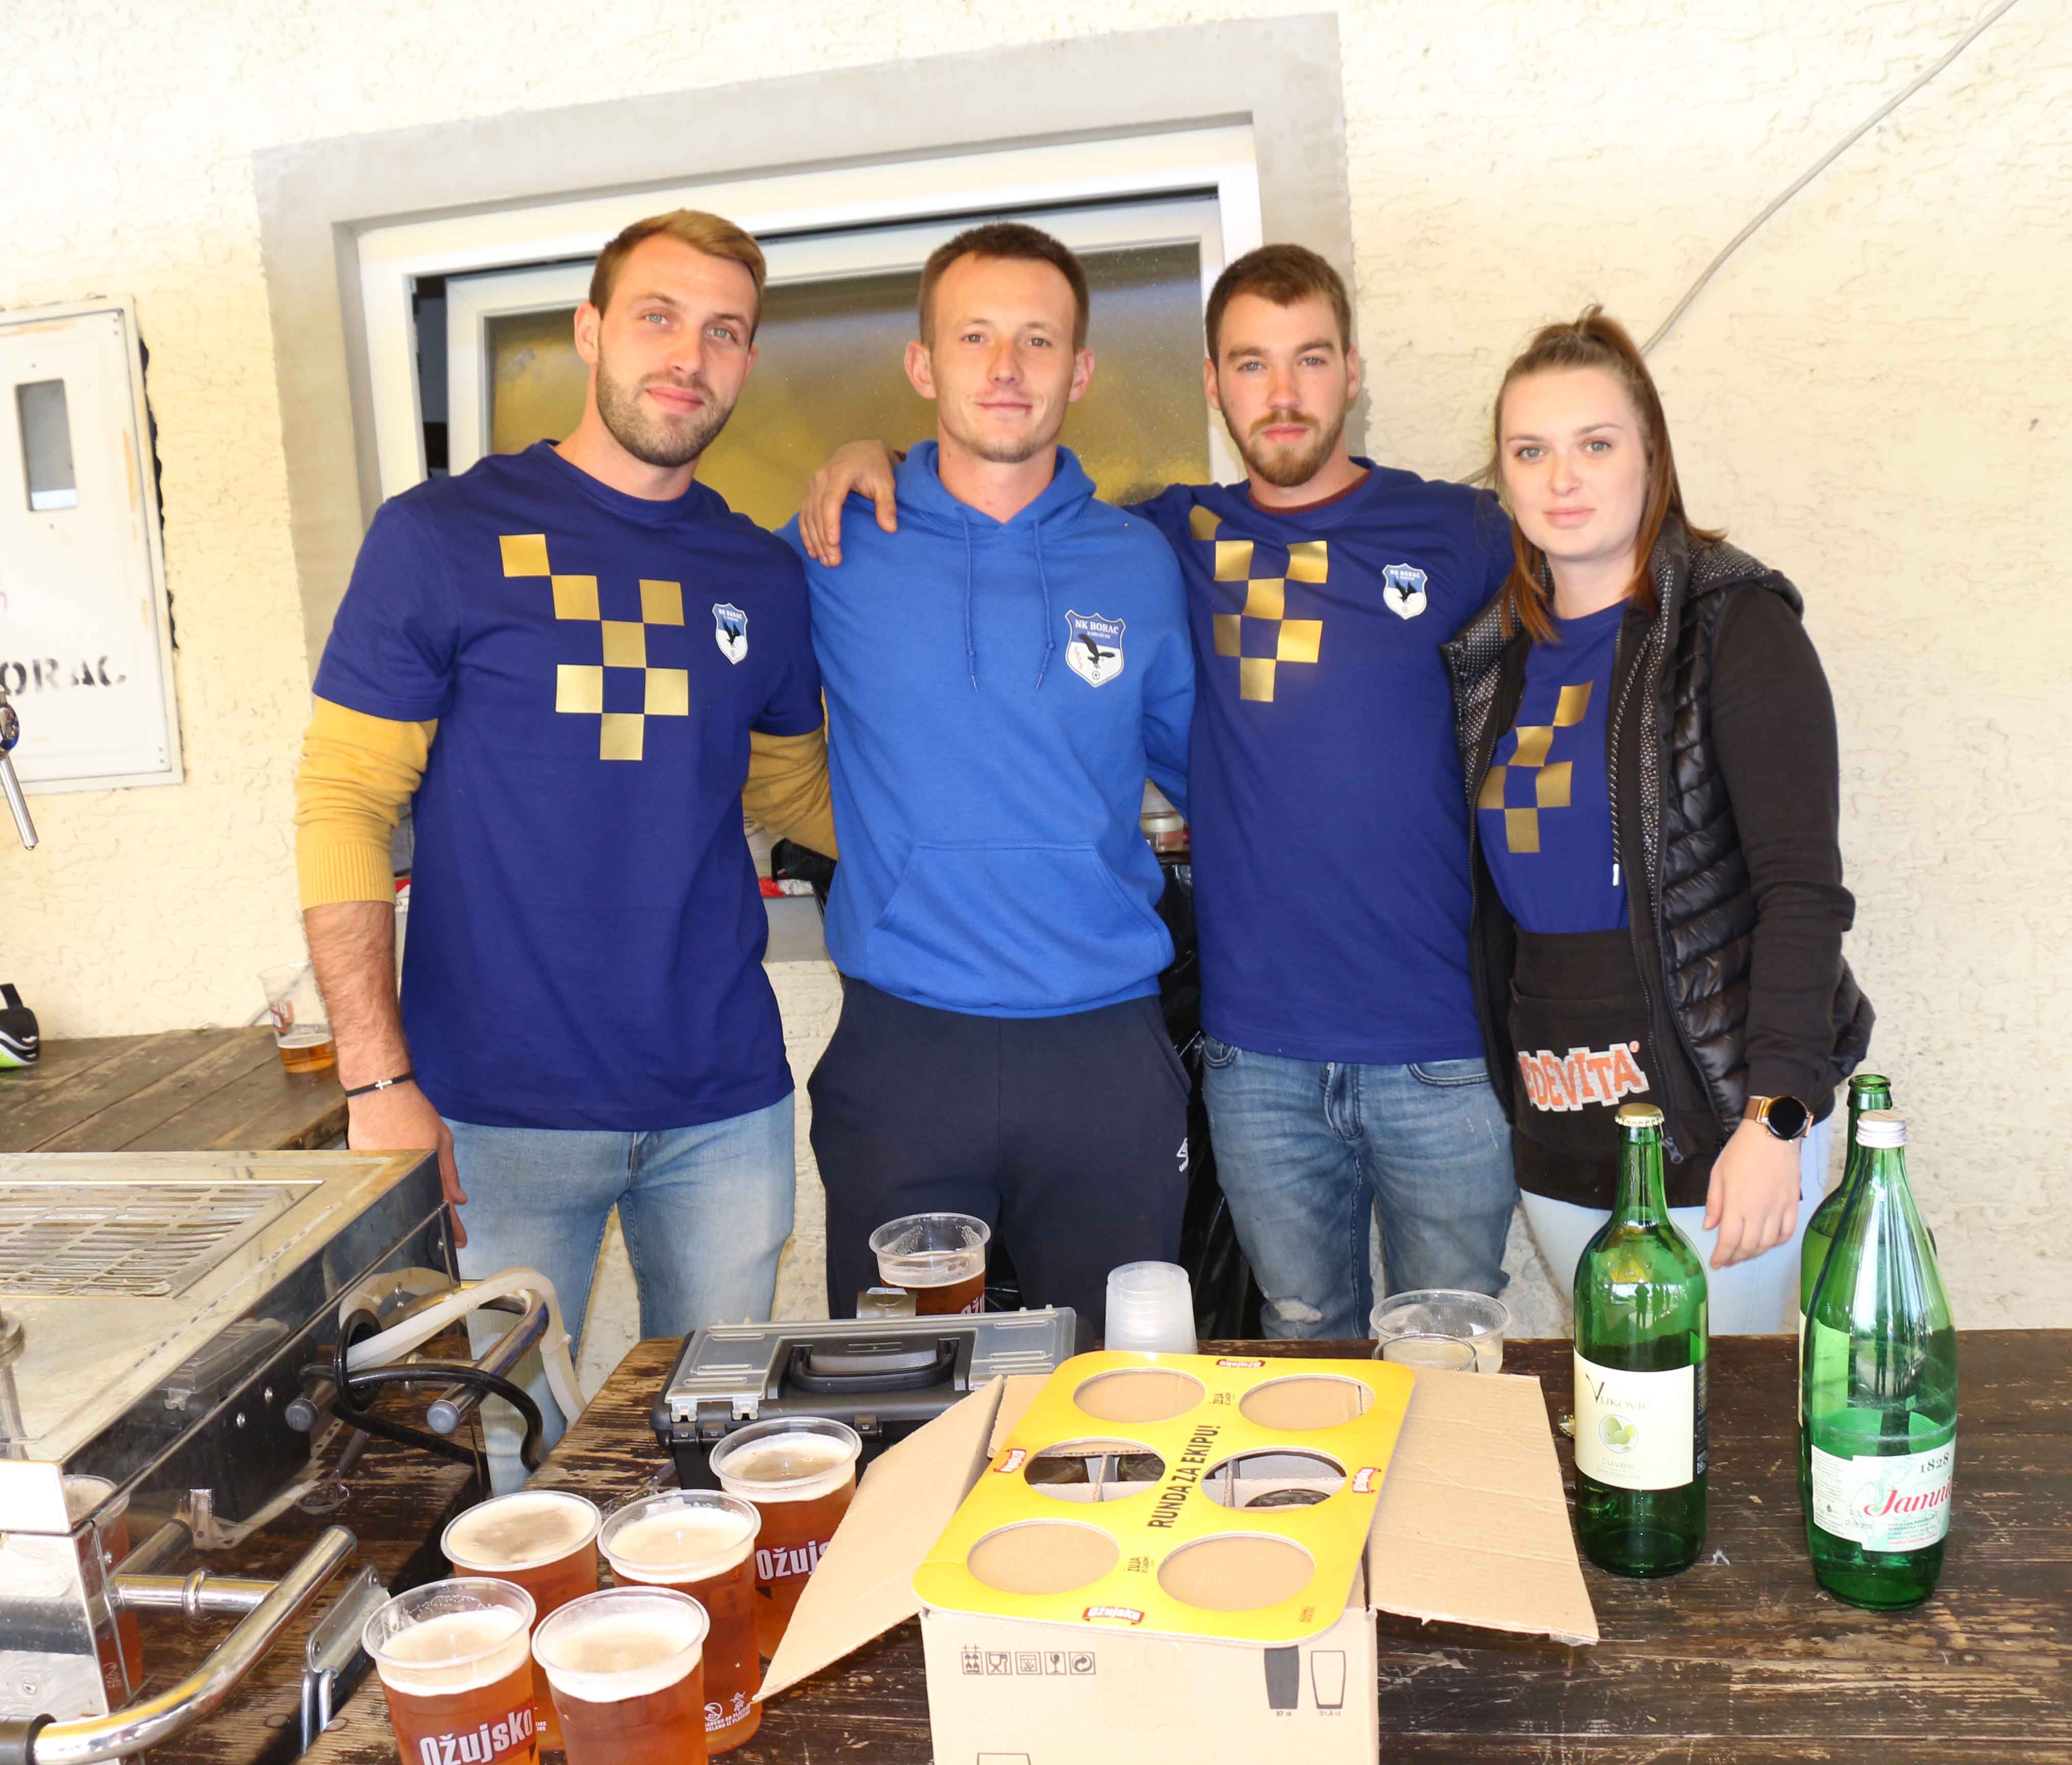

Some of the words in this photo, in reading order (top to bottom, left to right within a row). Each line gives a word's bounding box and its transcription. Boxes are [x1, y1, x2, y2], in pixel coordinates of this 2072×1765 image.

[1075, 619, 1088, 629] NK
[1090, 622, 1119, 634] BORAC
[1181, 1425, 1221, 1464] EKIPU!
[1171, 1468, 1201, 1483] ZA
[1920, 1451, 1949, 1473] 1828
[1147, 1486, 1192, 1528] RUNDA
[420, 1708, 533, 1765] Ožujsko
